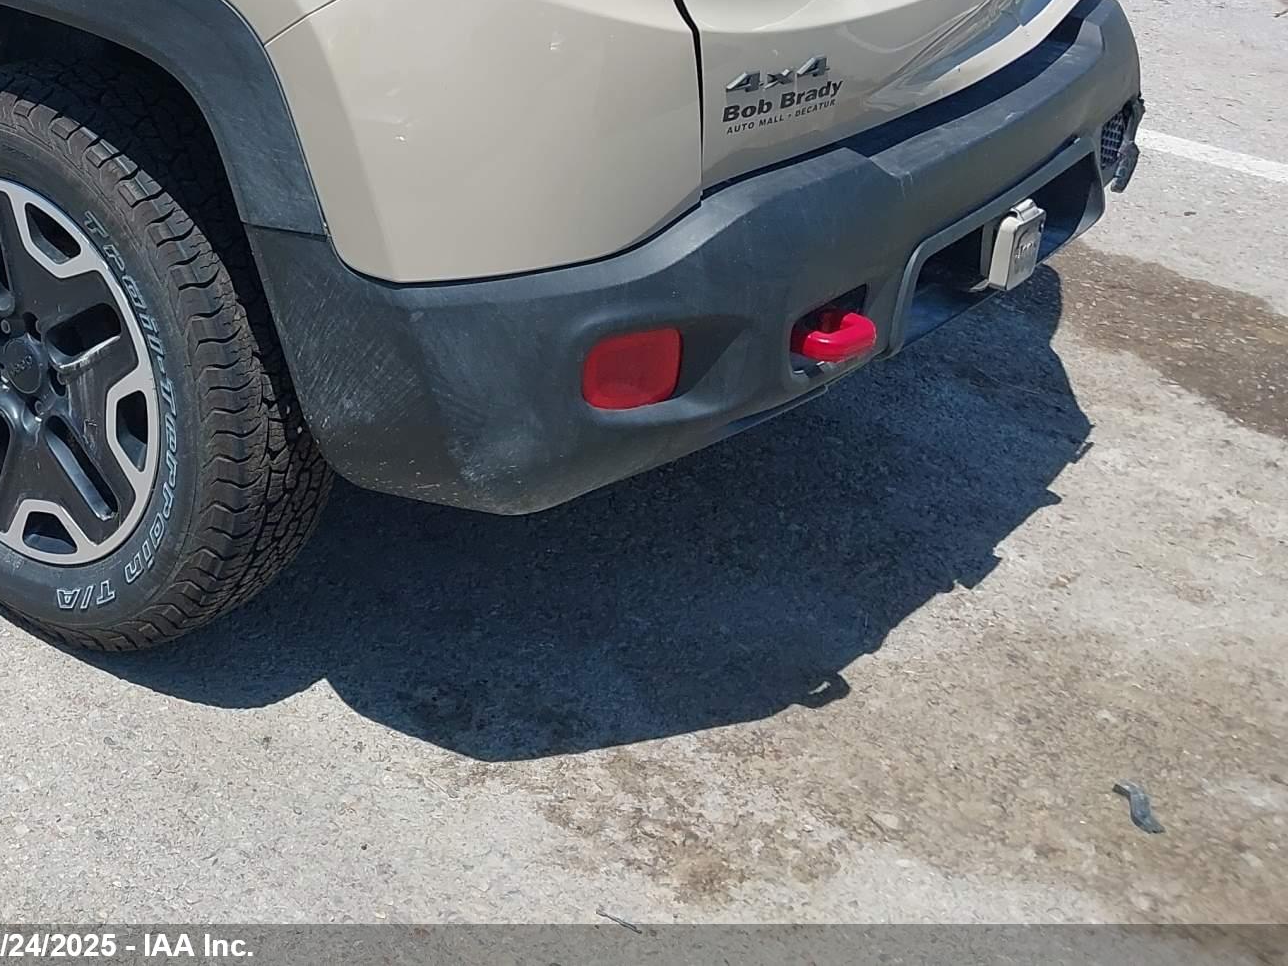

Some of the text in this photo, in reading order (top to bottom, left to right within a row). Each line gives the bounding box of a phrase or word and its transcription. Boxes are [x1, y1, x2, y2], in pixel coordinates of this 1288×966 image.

[722, 79, 843, 123] Bob Brady
[726, 98, 836, 135] AUTO MALL DECATUR
[55, 579, 116, 611] T/A
